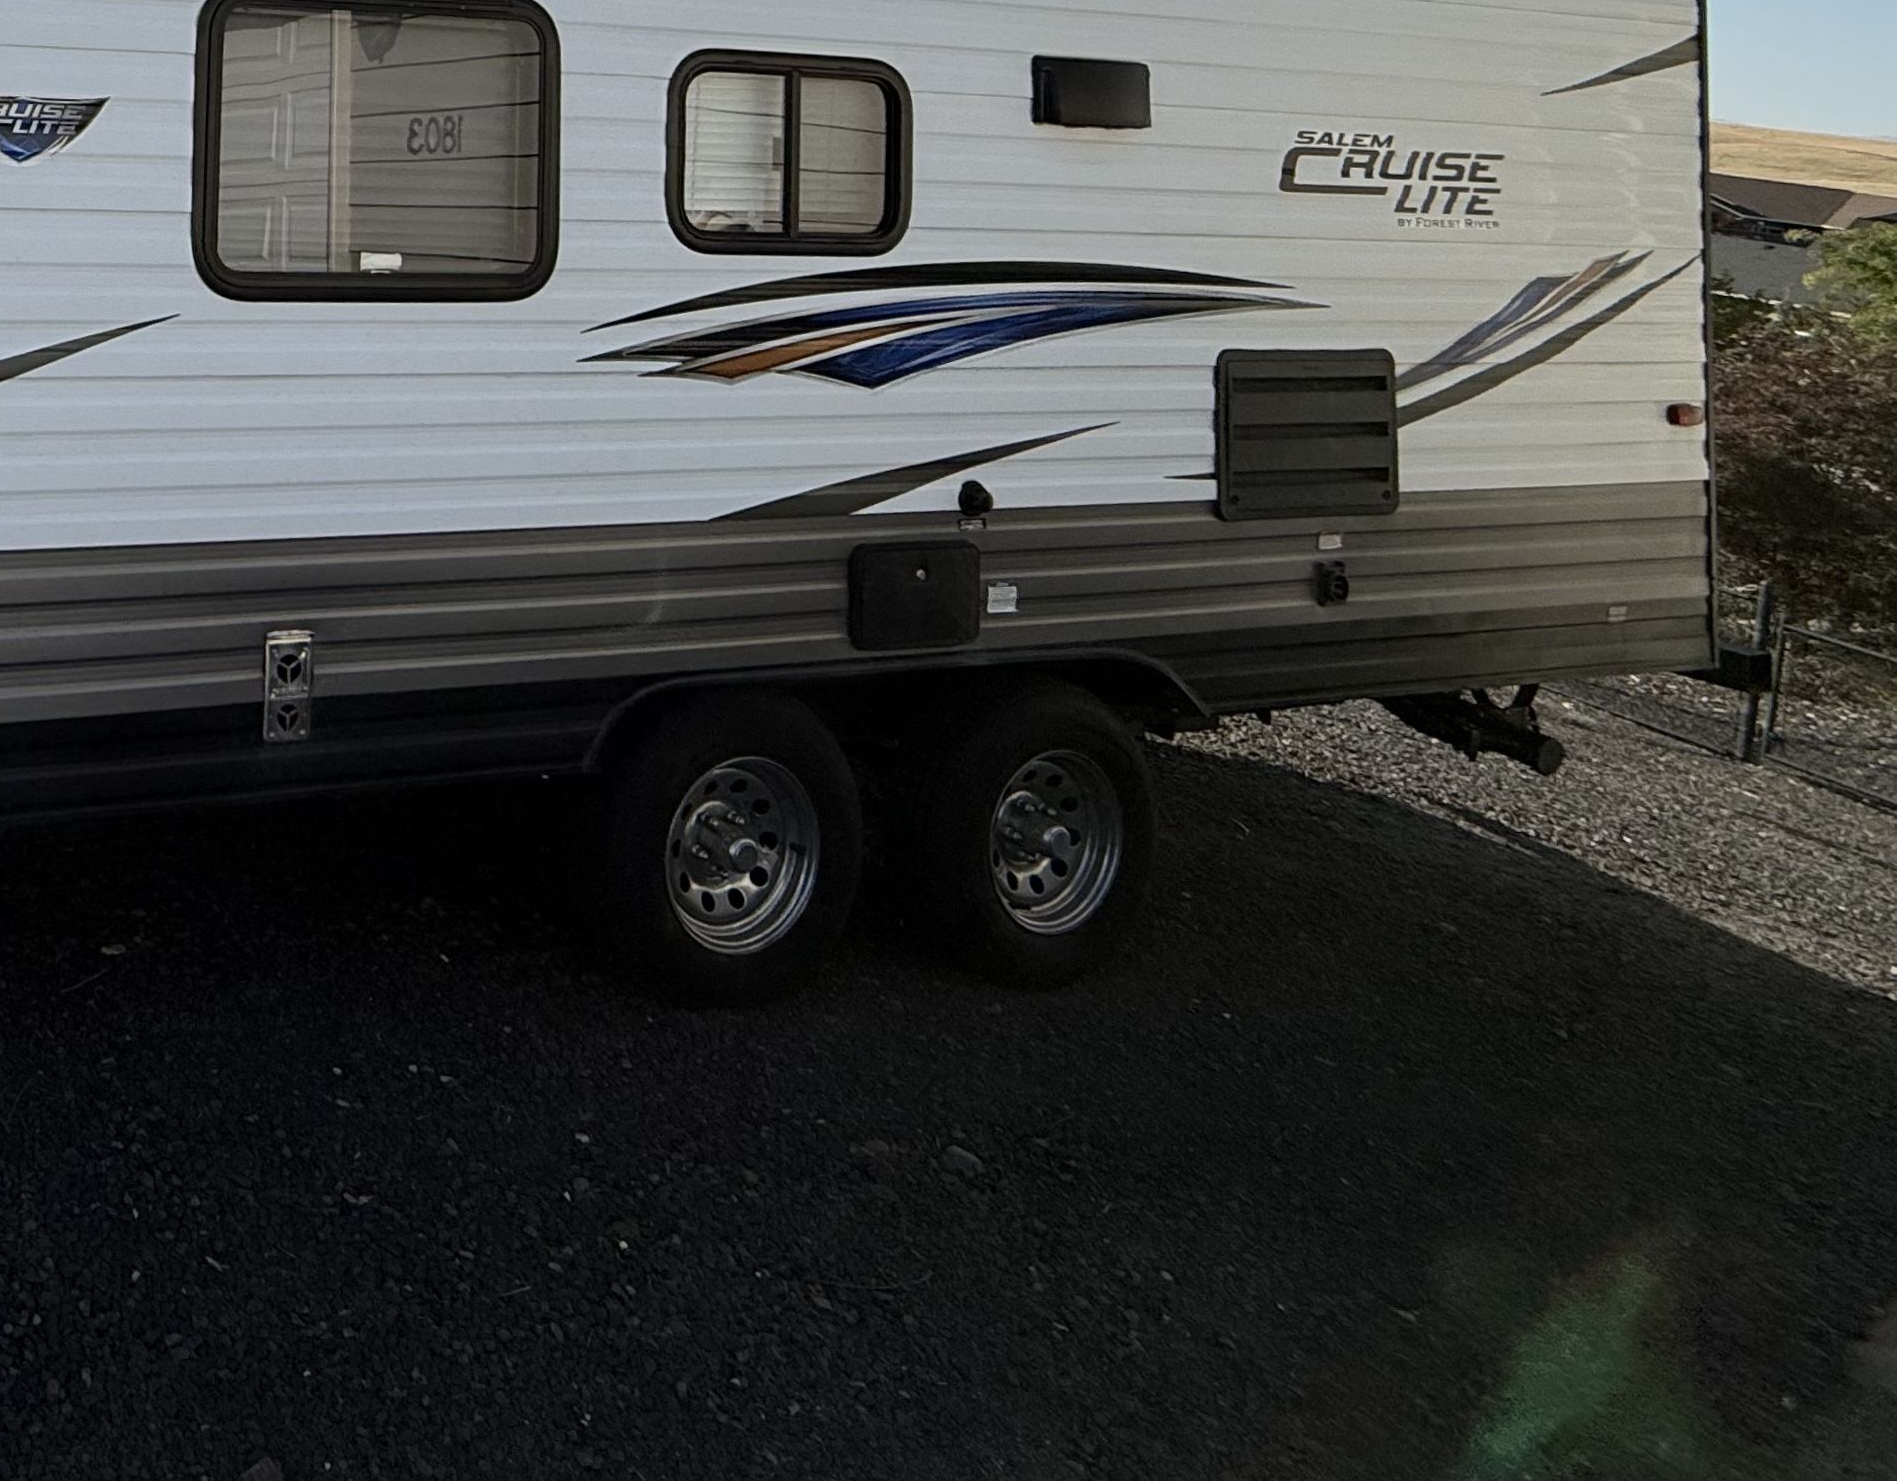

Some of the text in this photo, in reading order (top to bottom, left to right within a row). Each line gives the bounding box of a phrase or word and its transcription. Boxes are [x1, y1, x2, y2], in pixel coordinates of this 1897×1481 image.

[12, 119, 79, 135] LITE
[1294, 130, 1394, 148] SALEM
[1279, 146, 1506, 196] CRUISE
[1393, 184, 1502, 216] LITE
[1397, 217, 1500, 229] BY FOREST RIVER
